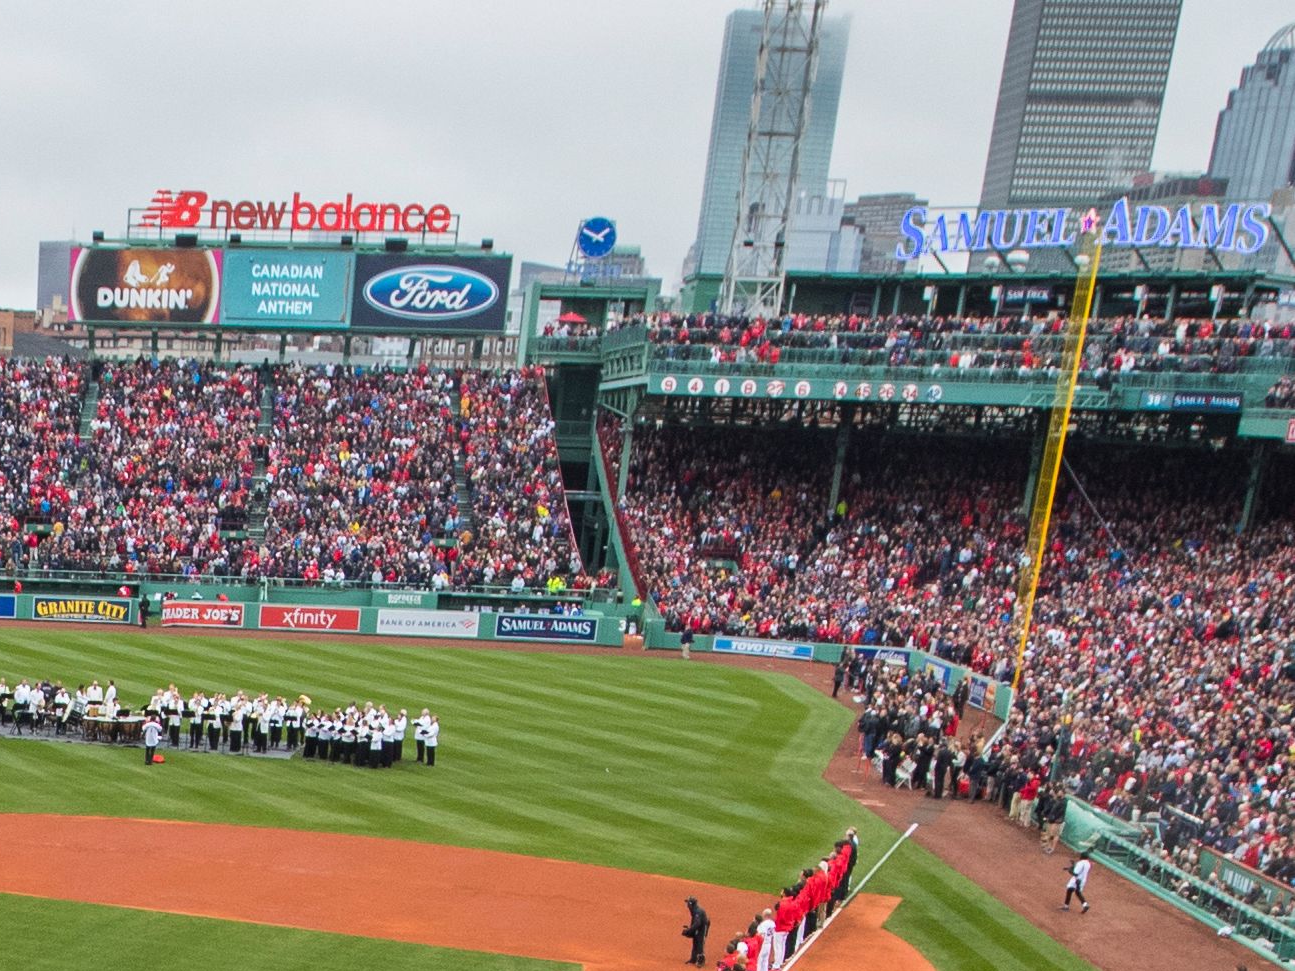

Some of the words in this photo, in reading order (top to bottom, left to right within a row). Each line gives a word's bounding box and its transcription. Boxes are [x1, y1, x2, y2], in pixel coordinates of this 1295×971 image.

[210, 198, 286, 231] new
[292, 192, 452, 233] balance
[896, 206, 1079, 262] SAMUEL
[1095, 196, 1273, 255] ADAMS
[251, 263, 324, 281] CANADIAN
[251, 281, 320, 298] NATIONAL
[388, 270, 474, 311] Ford
[96, 286, 193, 311] DUNKIN'
[256, 299, 313, 316] ANTHEM
[664, 379, 673, 392] 9
[690, 381, 699, 393] 4
[744, 383, 753, 395] 8
[36, 600, 95, 616] GRANITE
[97, 600, 128, 620] CITY
[162, 607, 199, 620] TRADER
[203, 608, 241, 621] JOE'S
[282, 607, 337, 629] xfinity
[380, 619, 403, 628] BANK
[406, 619, 417, 628] OF
[418, 620, 457, 629] AMERICA
[501, 618, 546, 632] SAMUEL
[550, 619, 592, 635] ADAMS
[731, 641, 763, 652] TOYO
